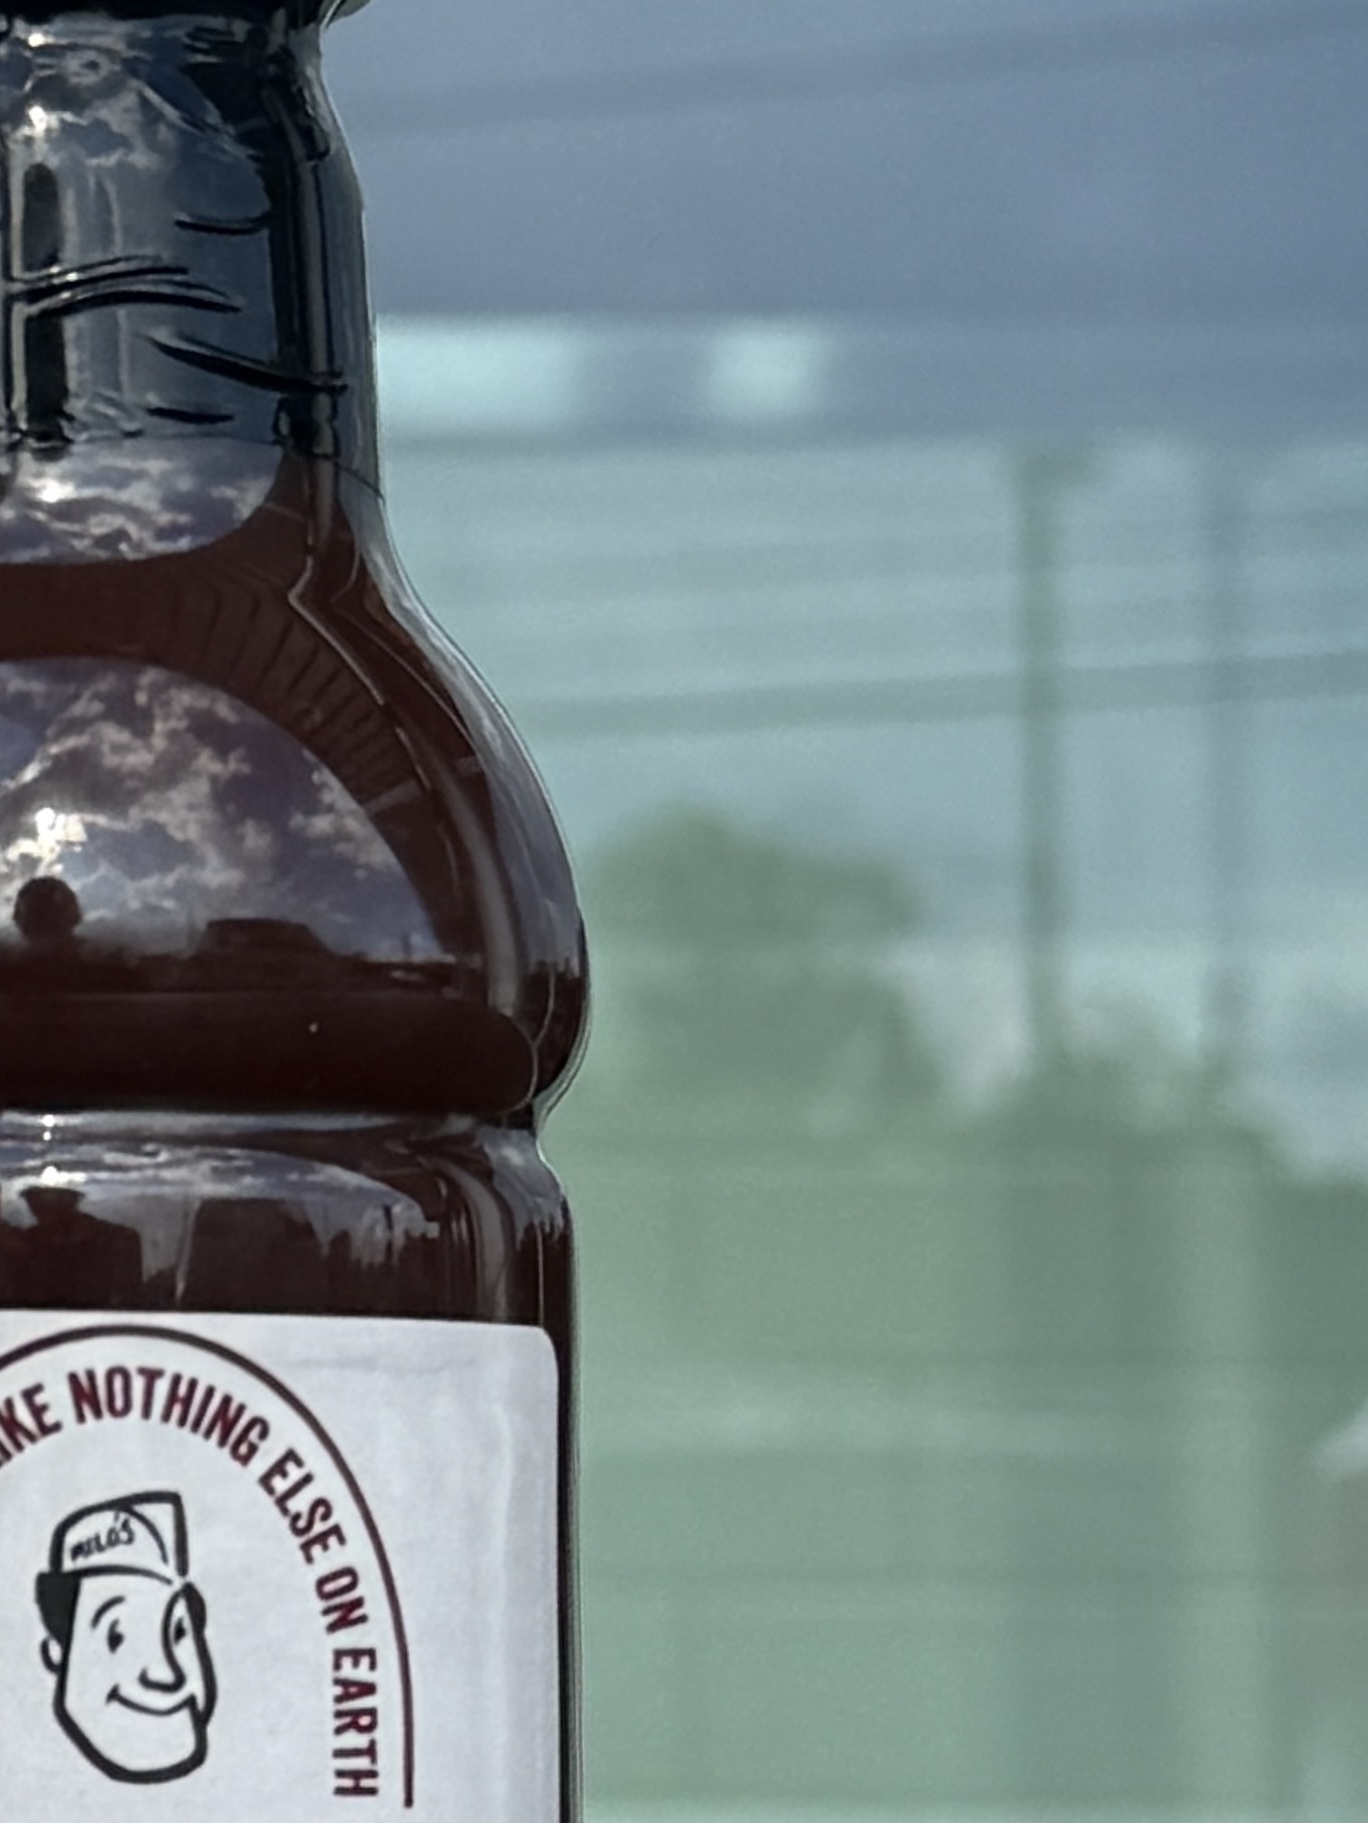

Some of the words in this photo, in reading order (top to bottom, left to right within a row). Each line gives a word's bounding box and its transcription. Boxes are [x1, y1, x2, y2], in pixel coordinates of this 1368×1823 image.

[68, 1366, 269, 1466] NOTHING
[258, 1448, 346, 1565] ELSE
[314, 1566, 369, 1635] ON
[333, 1647, 379, 1798] EARTH
